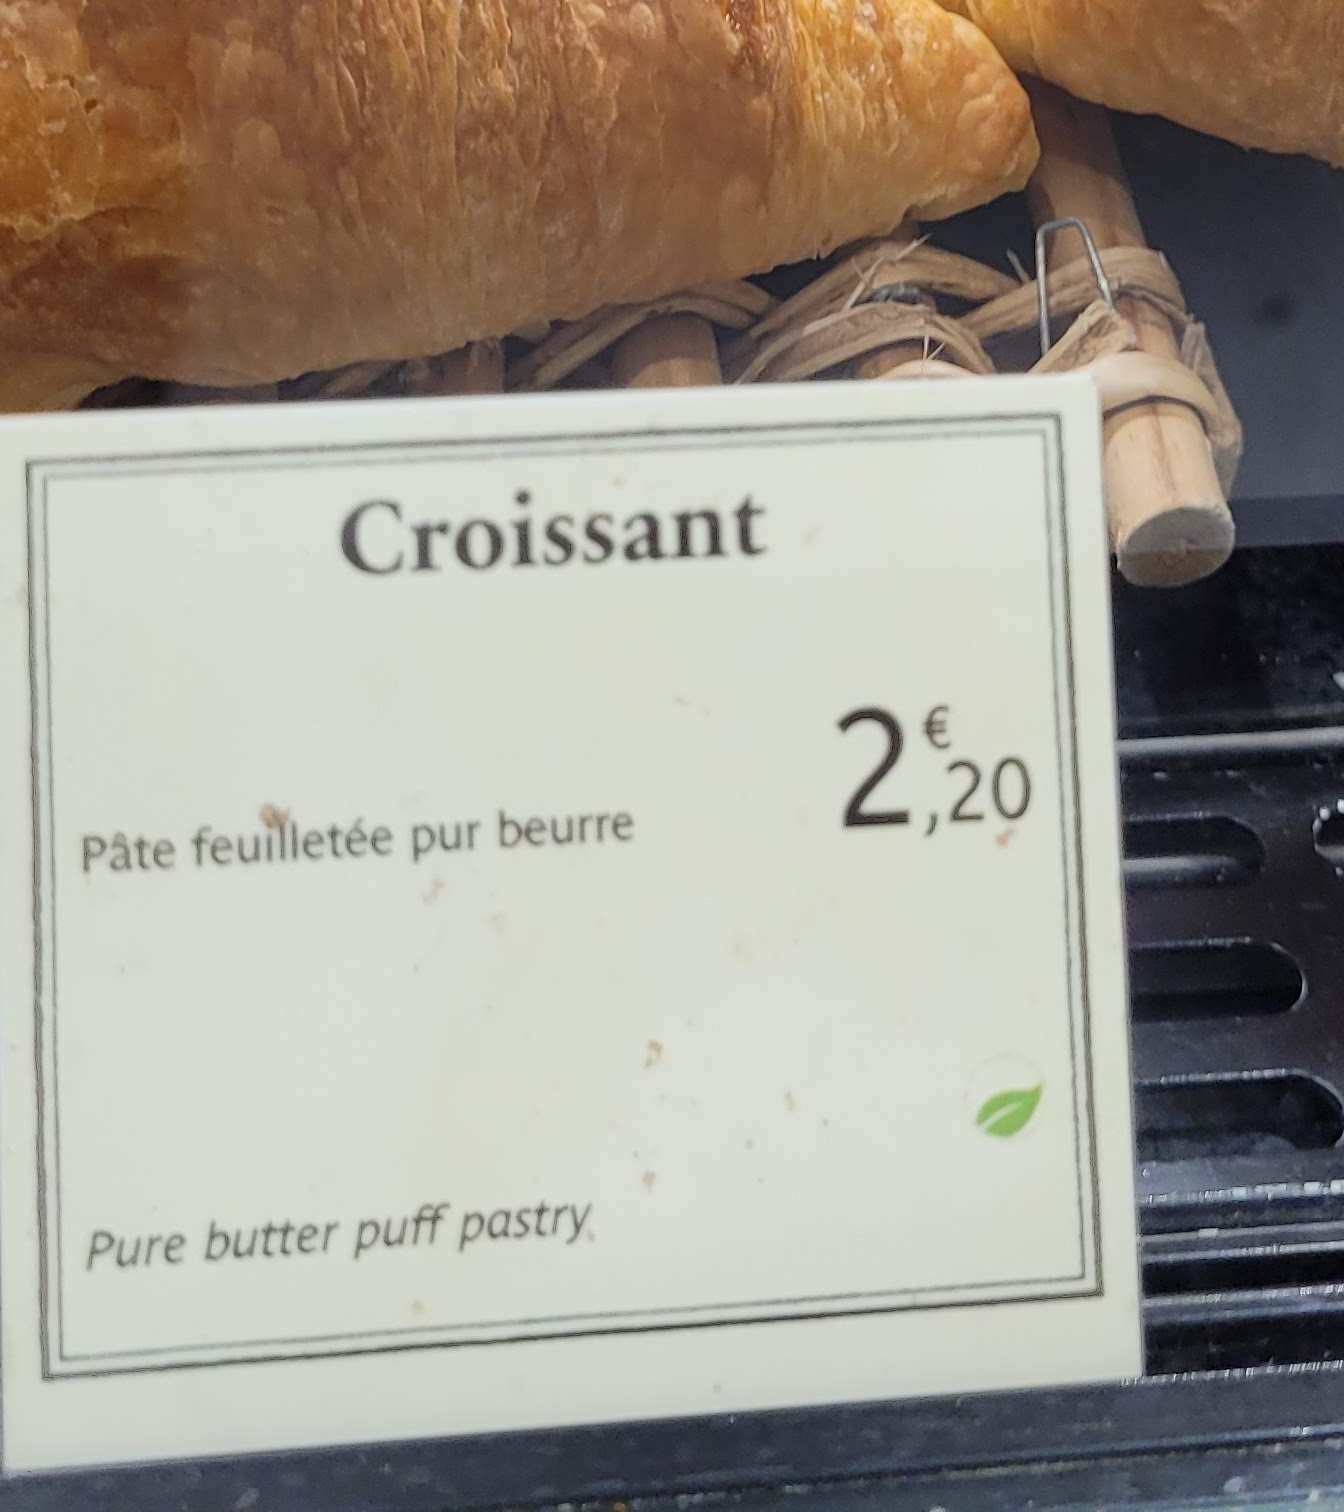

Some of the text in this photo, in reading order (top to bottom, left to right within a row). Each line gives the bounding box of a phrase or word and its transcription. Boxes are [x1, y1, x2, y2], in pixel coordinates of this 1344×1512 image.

[338, 488, 768, 576] Croissant
[81, 809, 635, 874] Pâte feuilletée pur beurre
[86, 1229, 187, 1271] Pure
[203, 1220, 340, 1263] butter
[353, 1201, 451, 1261] puff
